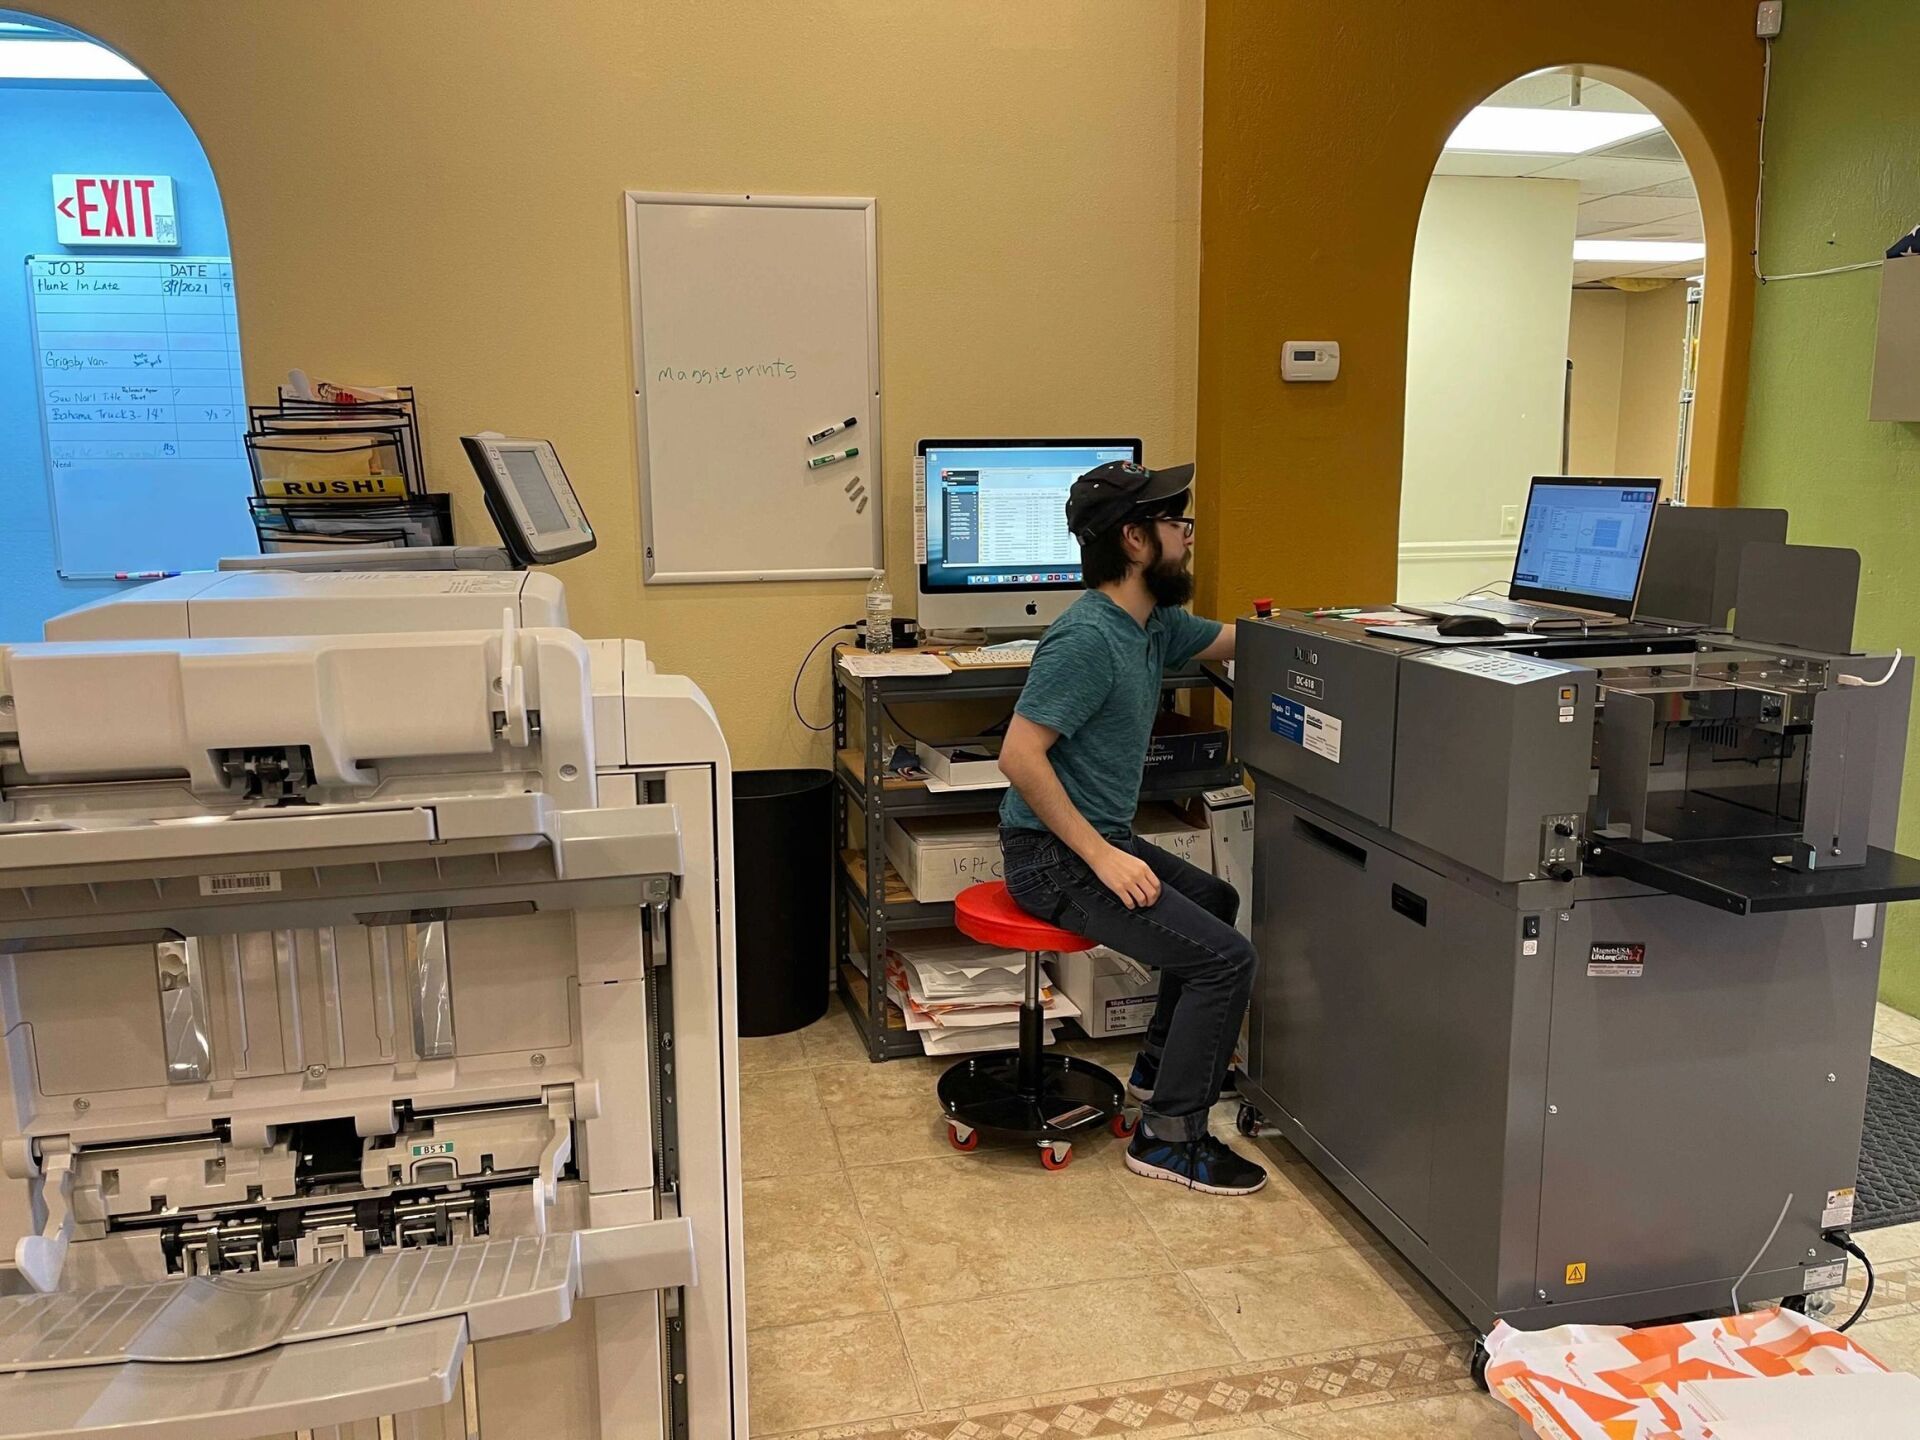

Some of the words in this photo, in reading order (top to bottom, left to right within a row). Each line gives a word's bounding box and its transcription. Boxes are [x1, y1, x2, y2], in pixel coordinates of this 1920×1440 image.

[75, 179, 155, 237] EXIT
[48, 261, 85, 276] JOB
[170, 264, 207, 277] DATE
[283, 480, 386, 495] RUSH!
[953, 857, 967, 875] 16
[424, 1145, 436, 1154] B5
